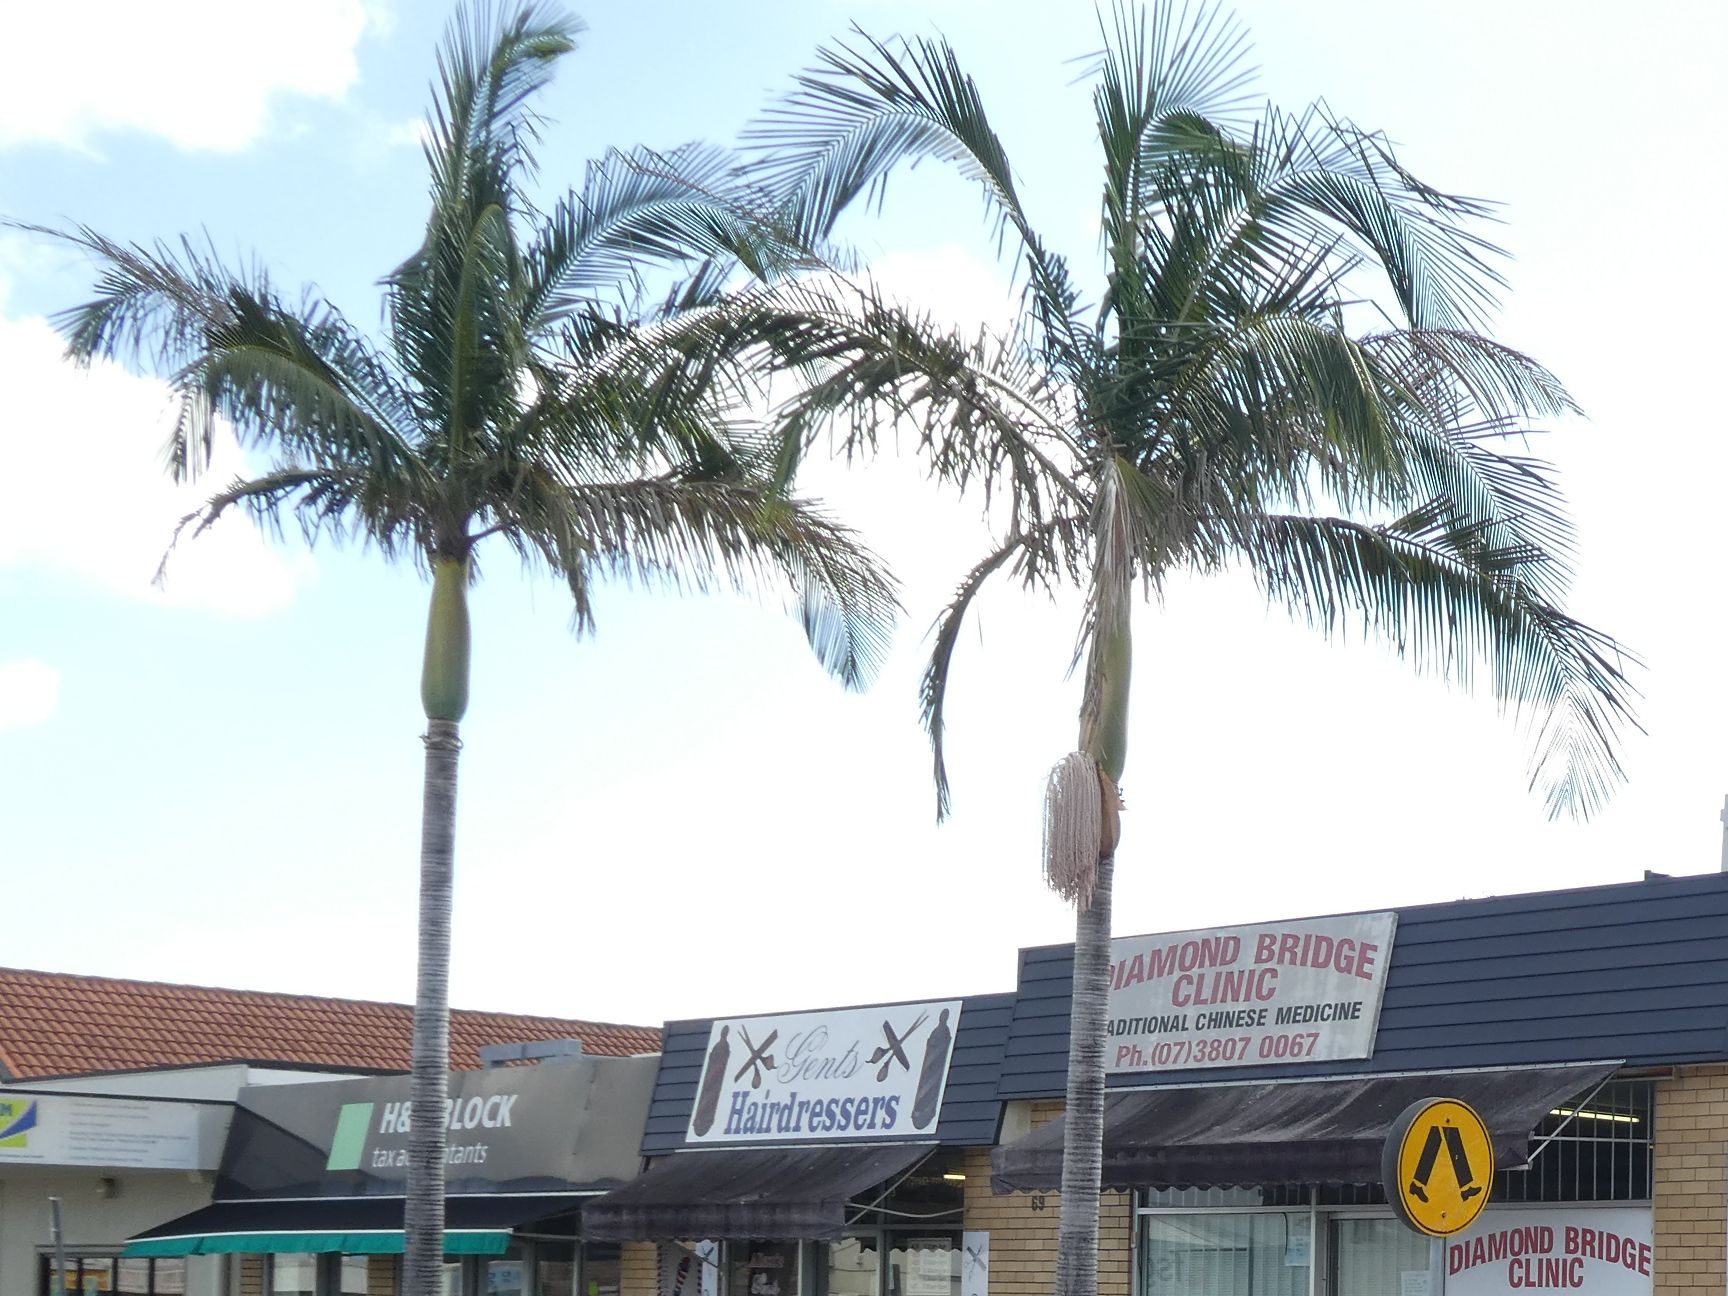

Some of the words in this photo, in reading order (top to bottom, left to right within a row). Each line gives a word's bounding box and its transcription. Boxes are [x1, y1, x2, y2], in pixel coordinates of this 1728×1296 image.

[1254, 933, 1379, 981] BRIDGE
[1171, 967, 1279, 1008] CLINIC
[1107, 1014, 1190, 1037] ADITIONAL
[1195, 1008, 1268, 1032] CHINESE
[1275, 1001, 1363, 1026] MEDICINE
[777, 1025, 862, 1084] Gents
[1115, 1035, 1252, 1068] Ph.(07)3807
[1258, 1032, 1321, 1059] 0067
[379, 1101, 412, 1134] H&
[723, 1089, 901, 1135] Hairdressers
[372, 1147, 396, 1167] tax
[1031, 1196, 1045, 1211] 69
[1449, 1226, 1554, 1276] DIAMOND
[1564, 1226, 1651, 1277] BRIDGE
[1508, 1257, 1584, 1288] CLINIC
